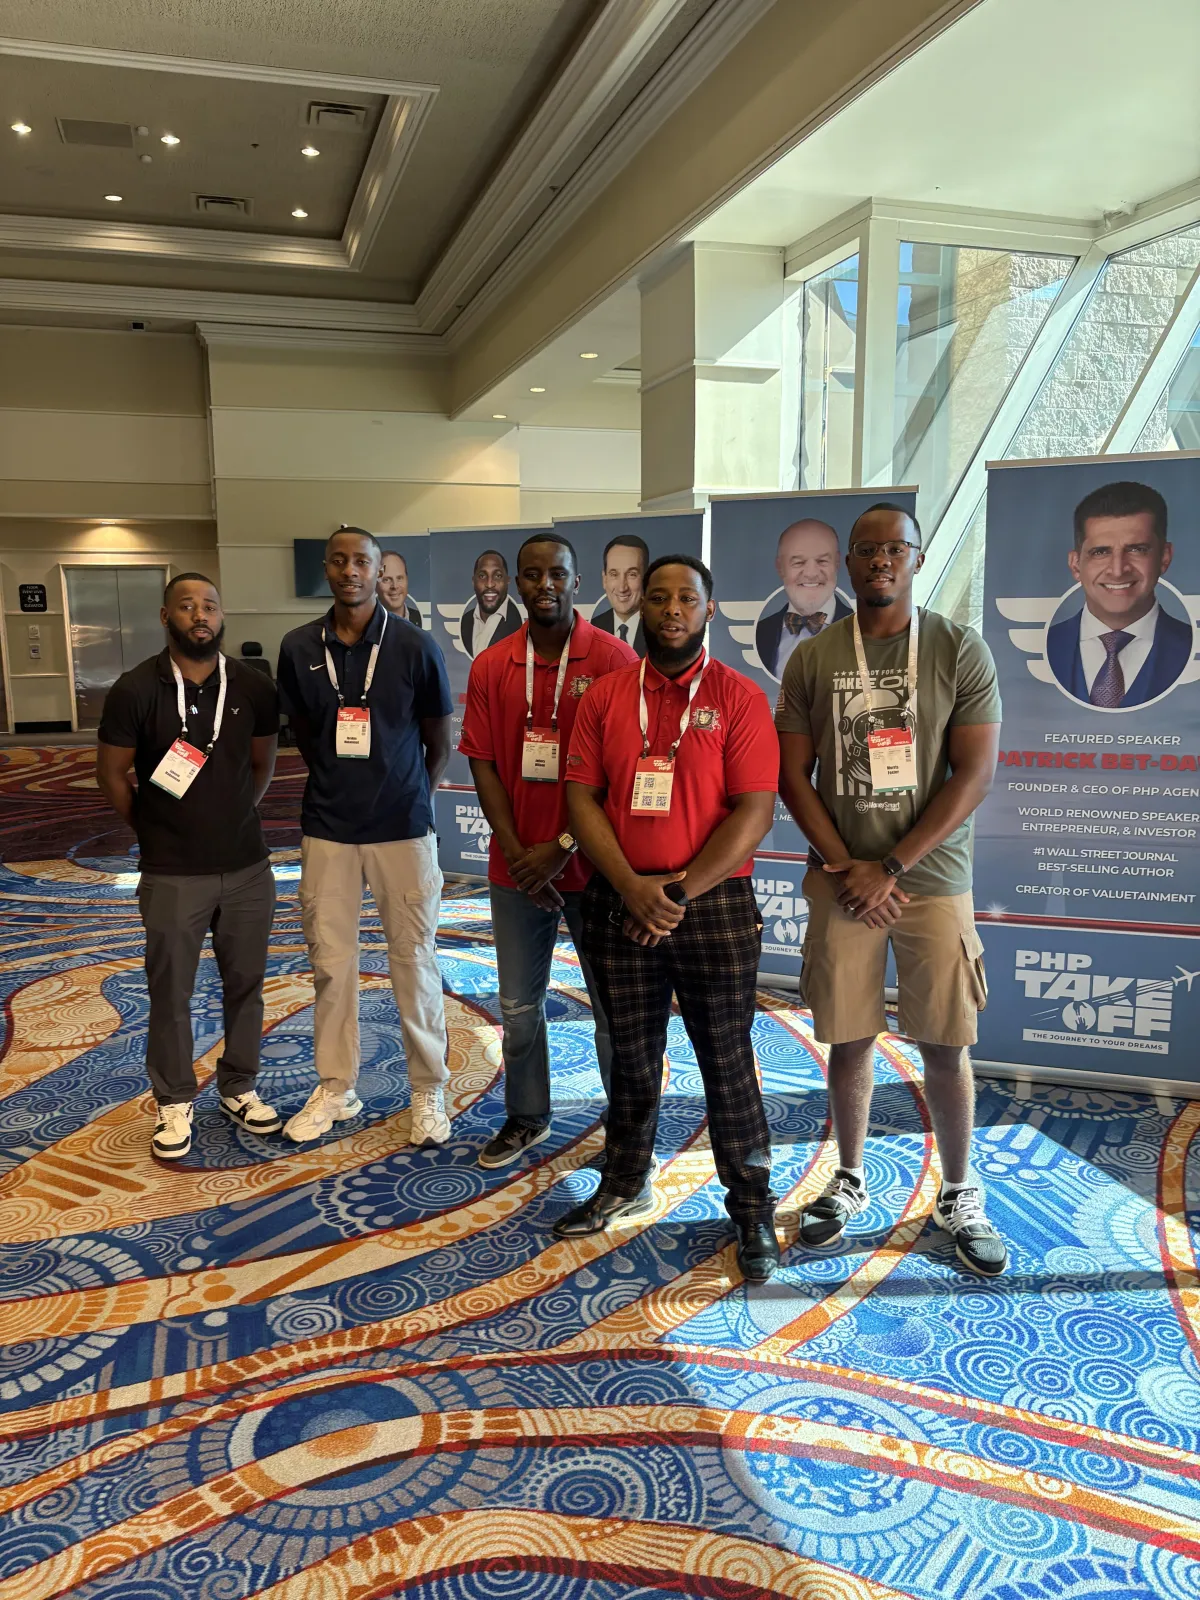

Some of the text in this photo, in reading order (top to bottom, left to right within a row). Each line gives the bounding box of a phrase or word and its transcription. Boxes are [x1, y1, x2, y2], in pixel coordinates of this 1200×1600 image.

[881, 668, 895, 676] FOR
[1044, 733, 1181, 746] FEATURED SPEAKER
[1101, 753, 1200, 772] BET-DA
[1008, 782, 1068, 793] FOUNDER
[1071, 784, 1079, 793] &
[1082, 784, 1109, 795] CEO
[1111, 785, 1130, 795] OF
[1132, 786, 1160, 796] PHP
[1018, 806, 1063, 818] WORLD
[1066, 808, 1139, 820] RENOWNED
[1022, 822, 1196, 838] ENTREPRENEUR, & INVESTOR
[1032, 847, 1179, 862] #1 WALL STREET JOURNAL
[1037, 862, 1175, 878] BEST-SELLING AUTHOR
[1015, 884, 1196, 903] CREATOR OF VALUETAINMENT
[764, 945, 792, 953] JOURNEY
[1015, 949, 1093, 972] PHP
[1014, 969, 1174, 1010] TAKE
[1062, 1000, 1172, 1037] OFF
[1032, 1032, 1164, 1051] THE JOURNEY TO YOUR DREAMS
